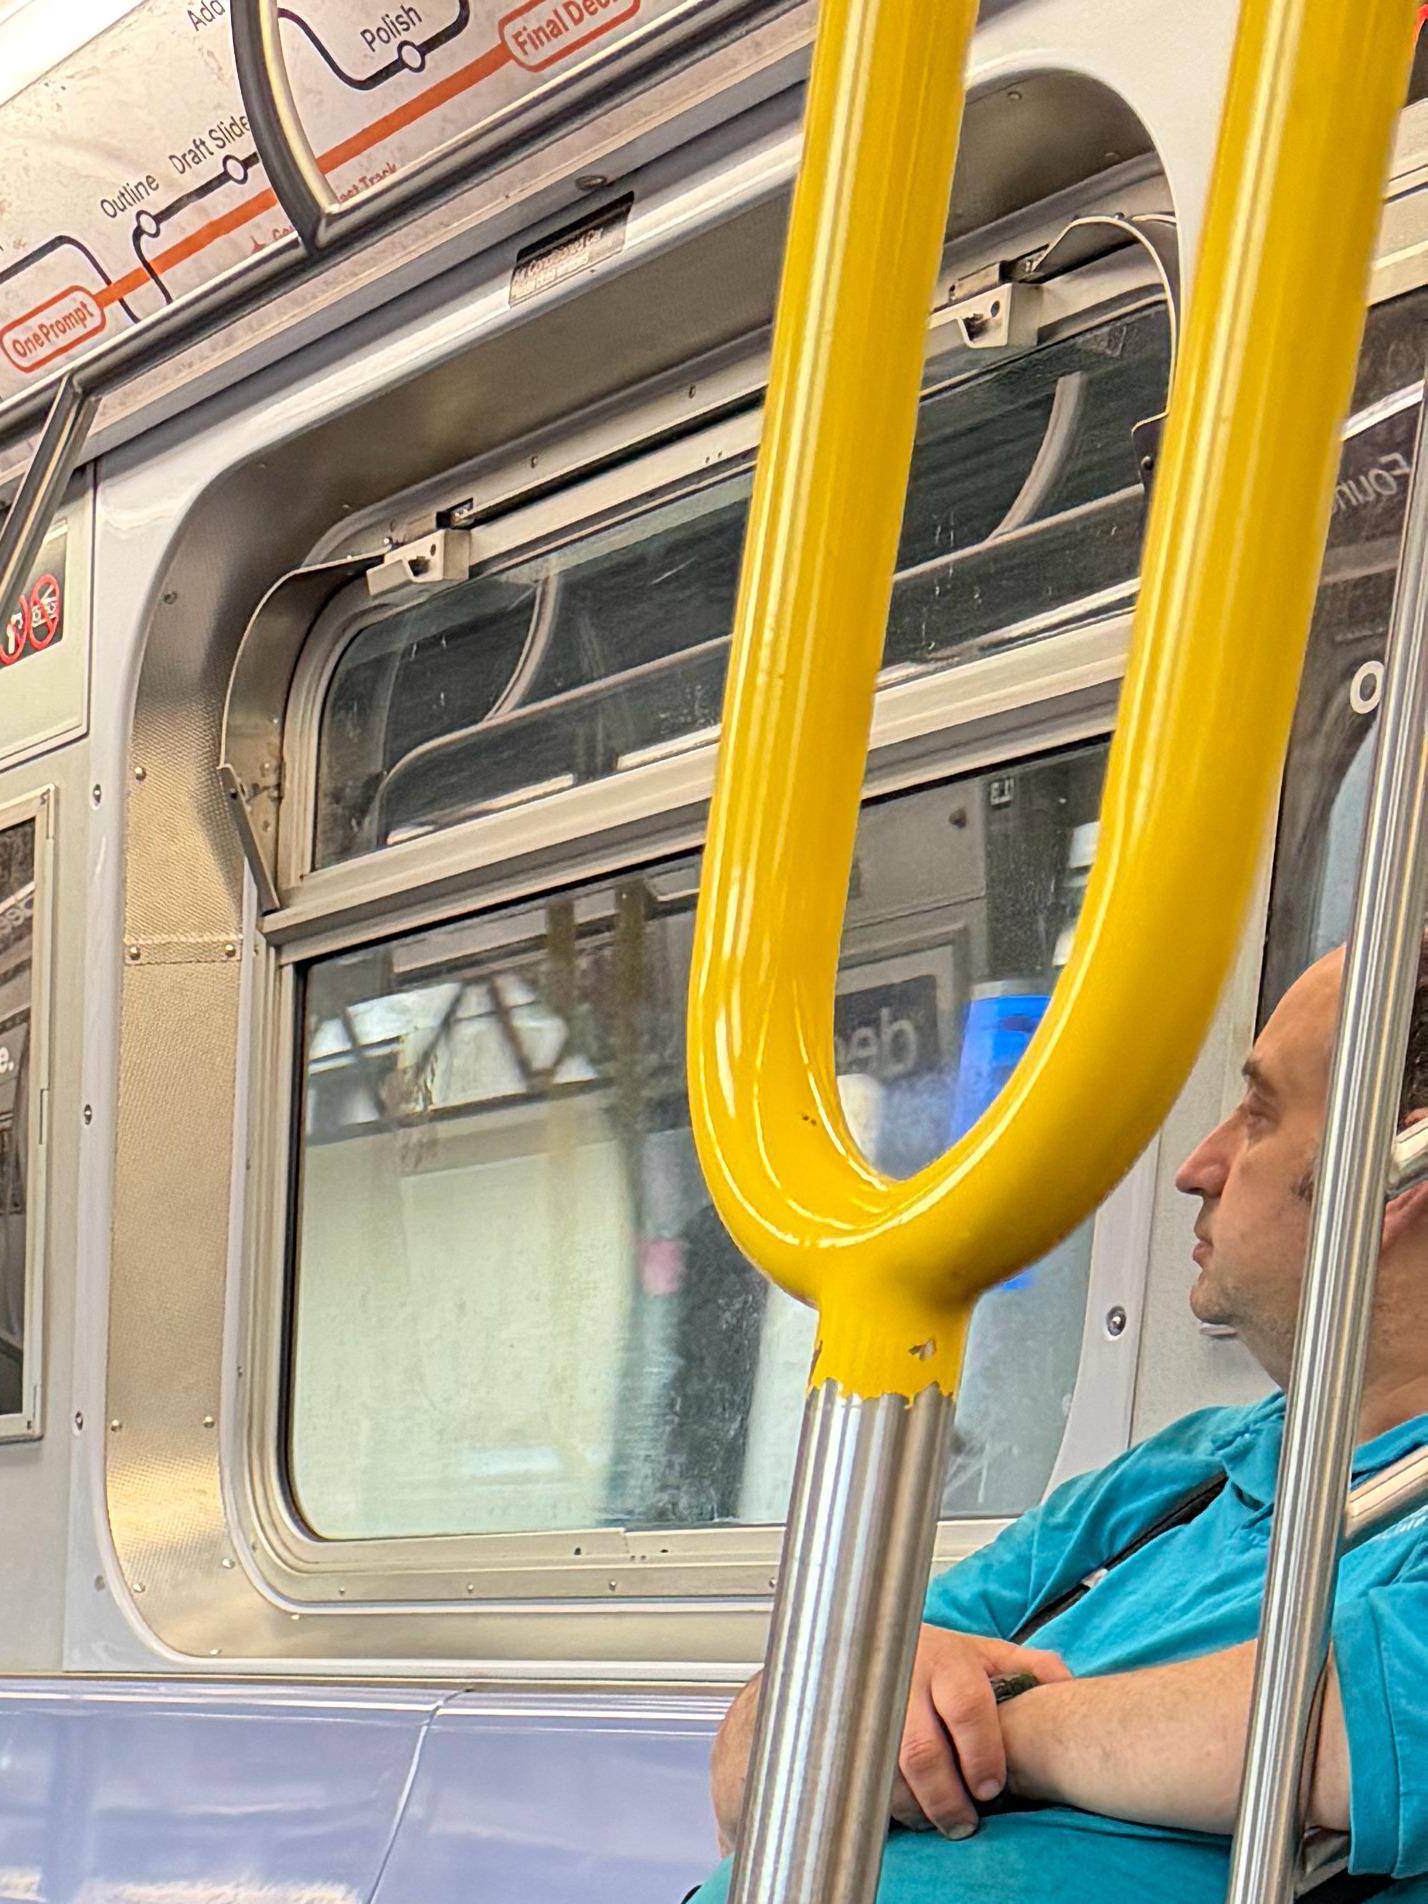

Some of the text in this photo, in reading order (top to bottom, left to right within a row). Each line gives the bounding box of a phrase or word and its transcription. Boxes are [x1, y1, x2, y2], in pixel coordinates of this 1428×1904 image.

[359, 5, 424, 54] Polish
[511, 8, 570, 56] Final
[167, 114, 250, 175] Draft Slide
[100, 171, 160, 220] Outline
